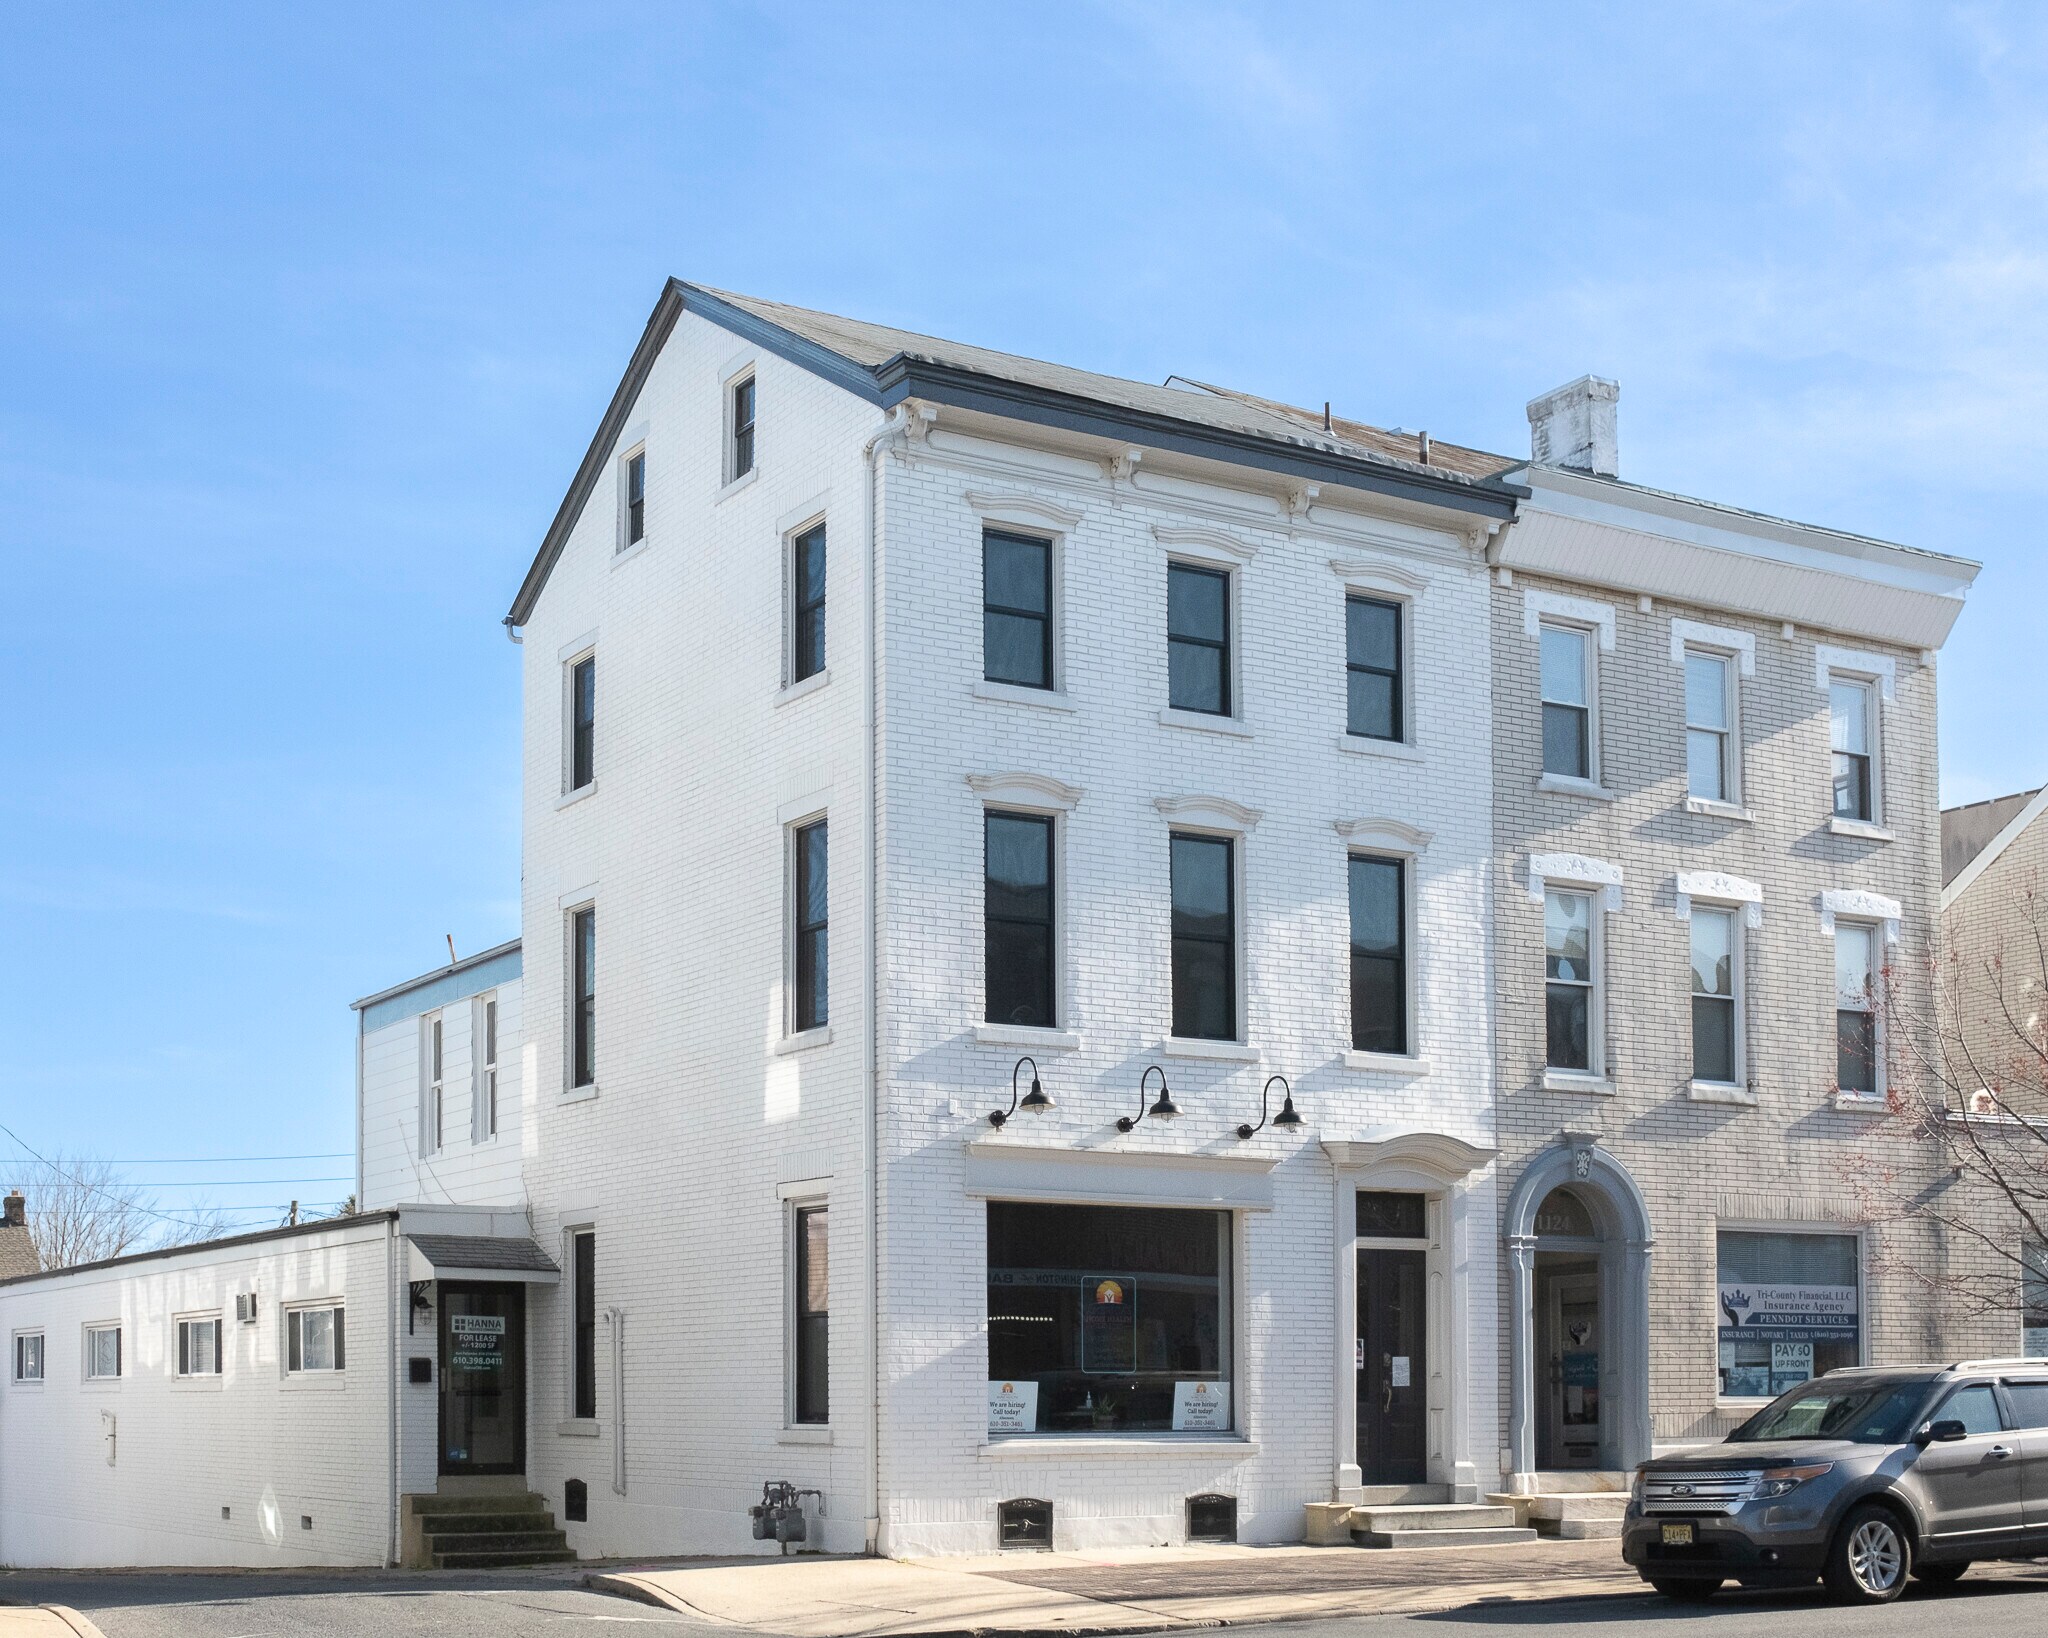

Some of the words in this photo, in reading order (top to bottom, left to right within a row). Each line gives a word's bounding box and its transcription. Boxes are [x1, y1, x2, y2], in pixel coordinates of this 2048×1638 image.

[1536, 1214, 1569, 1232] 1124
[1757, 1290, 1796, 1302] Tri-County
[1799, 1291, 1834, 1301] Financial,
[1835, 1291, 1852, 1301] LLC
[1764, 1301, 1810, 1310] Insurance
[1814, 1302, 1845, 1313] Agency
[467, 1319, 502, 1328] HANNA
[1760, 1314, 1803, 1324] PENNDOT
[1805, 1315, 1849, 1325] SERVICES
[1760, 1331, 1785, 1339] NOTARY
[1790, 1331, 1809, 1339] TAXES
[1775, 1344, 1796, 1356] PAY
[452, 1356, 503, 1365] 610.398.0411
[1775, 1360, 1785, 1368] UP
[1786, 1360, 1811, 1368] FRONT
[1008, 1401, 1026, 1409] hiring!
